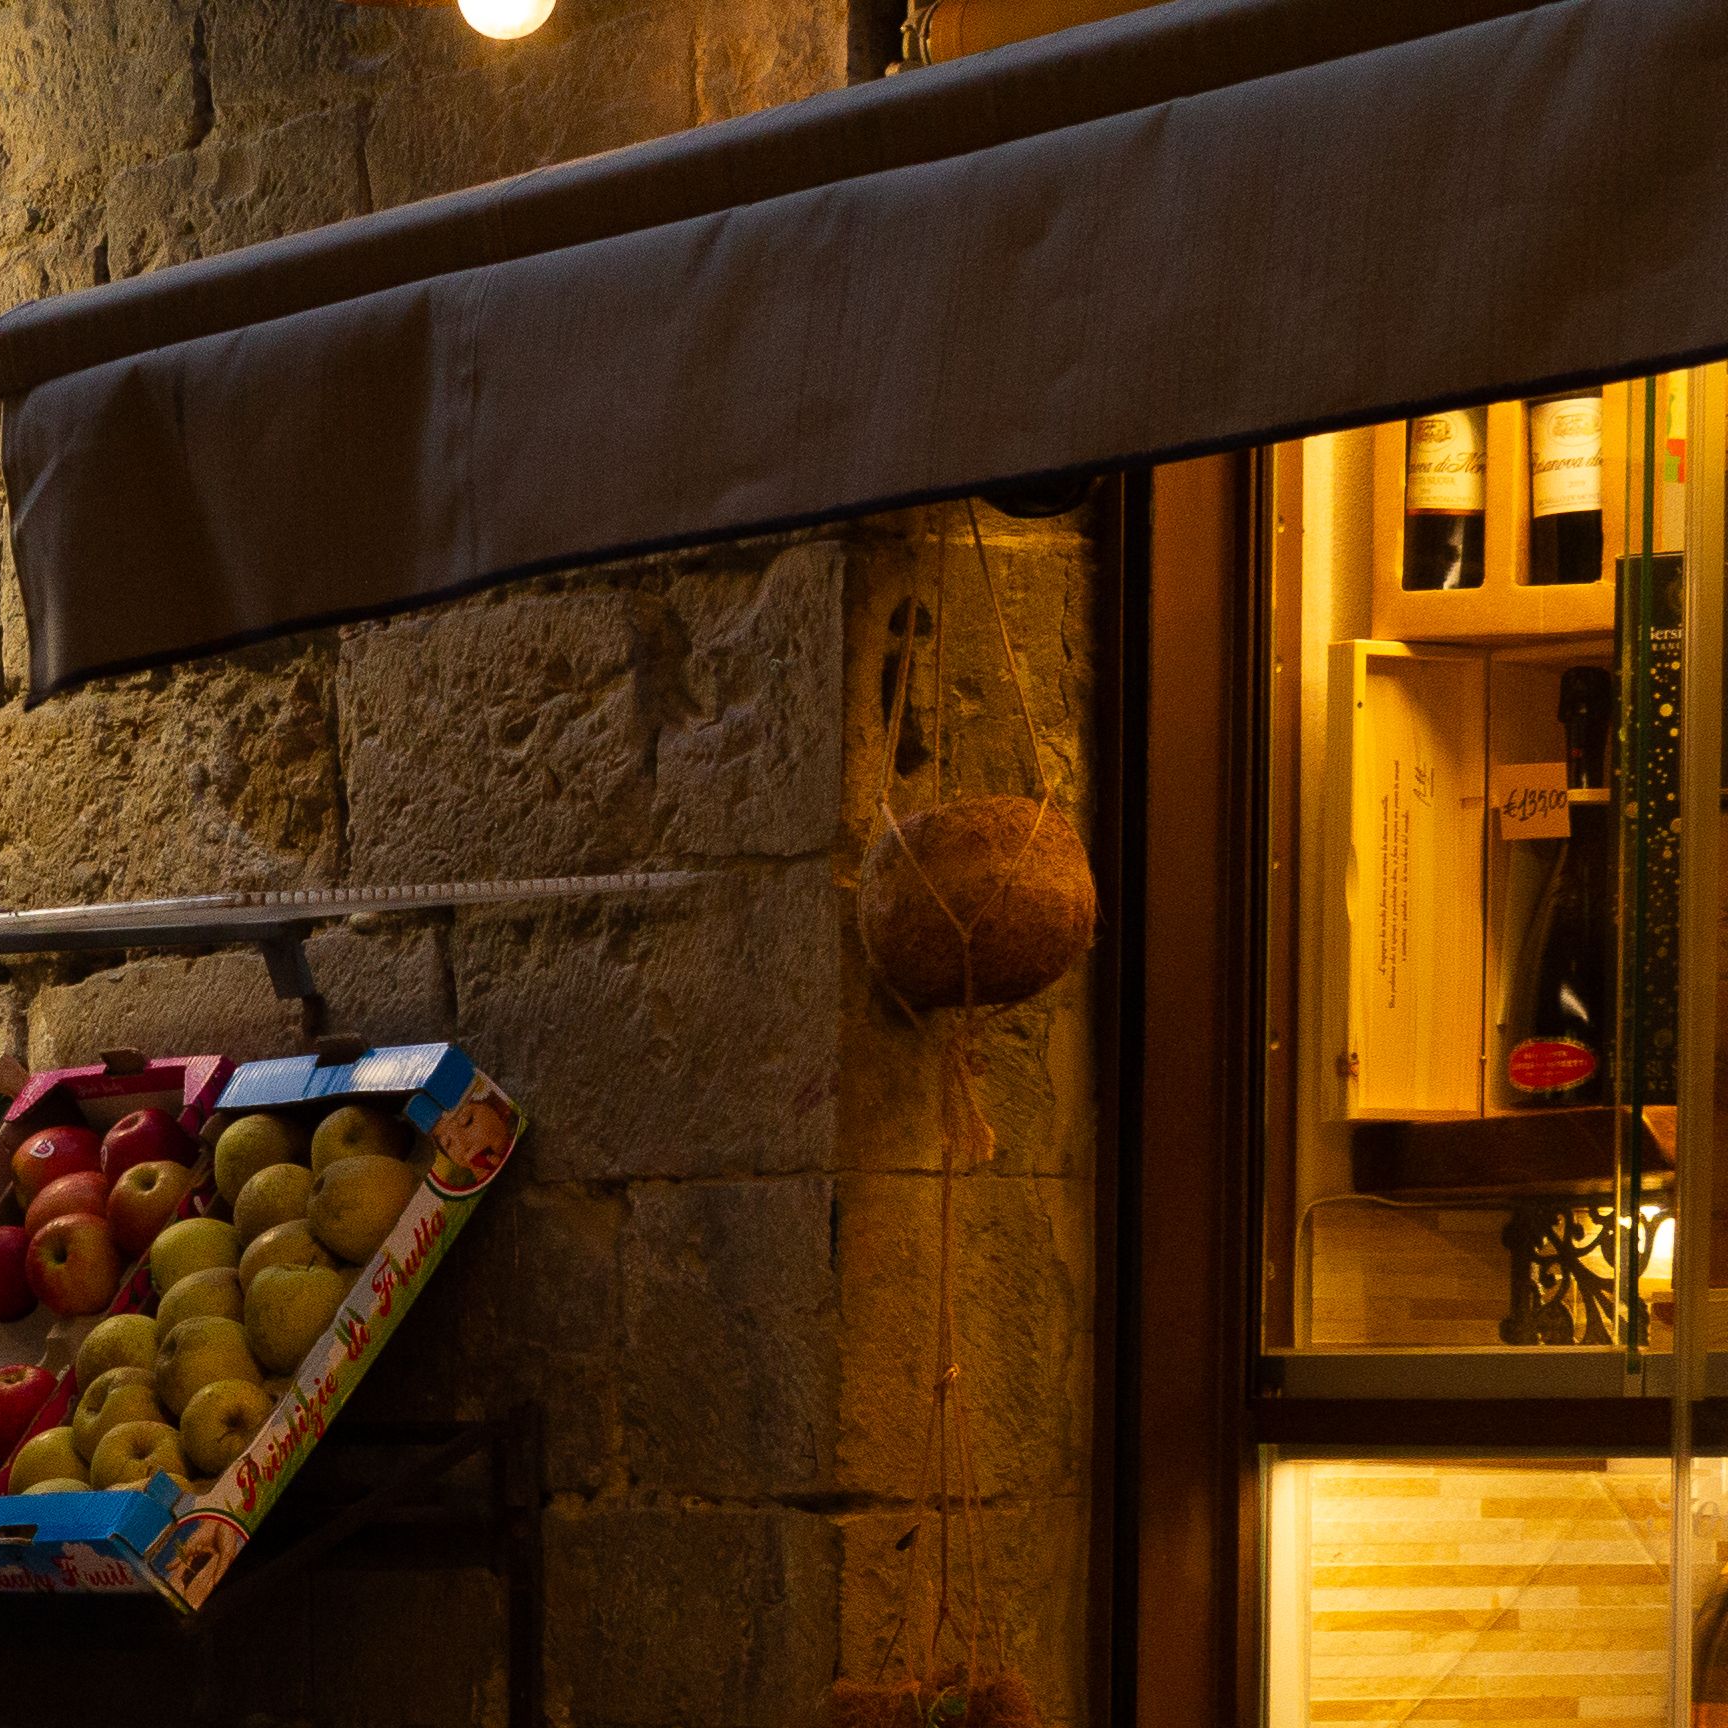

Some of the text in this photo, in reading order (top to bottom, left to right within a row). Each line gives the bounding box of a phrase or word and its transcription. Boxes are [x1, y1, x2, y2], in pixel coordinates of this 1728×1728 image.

[236, 1209, 446, 1512] Primizie di Frutta
